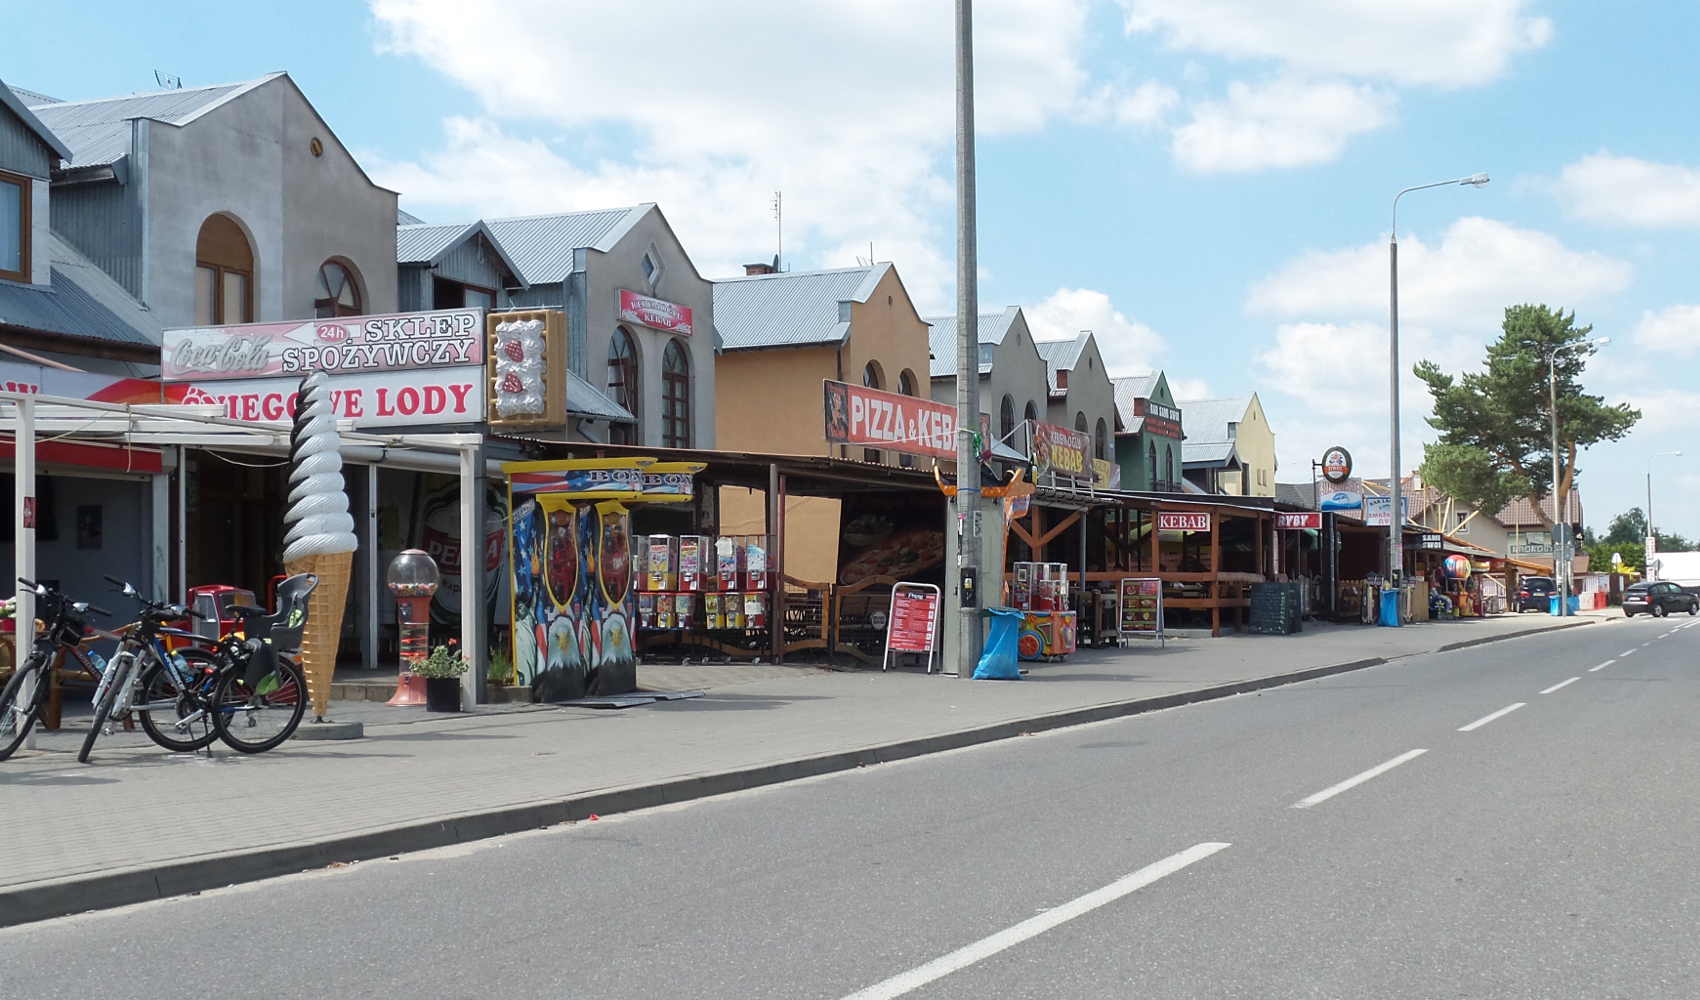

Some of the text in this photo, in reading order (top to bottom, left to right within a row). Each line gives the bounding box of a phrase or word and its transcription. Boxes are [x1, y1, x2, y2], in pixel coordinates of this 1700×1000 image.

[320, 326, 344, 339] 24h
[365, 314, 475, 343] SKLEP
[281, 338, 475, 373] SPOŻYWCZY
[376, 384, 473, 416] LODY
[852, 395, 959, 451] PIZZA & KEBA
[1160, 515, 1206, 528] KEBAB
[1278, 515, 1308, 527] RYBY
